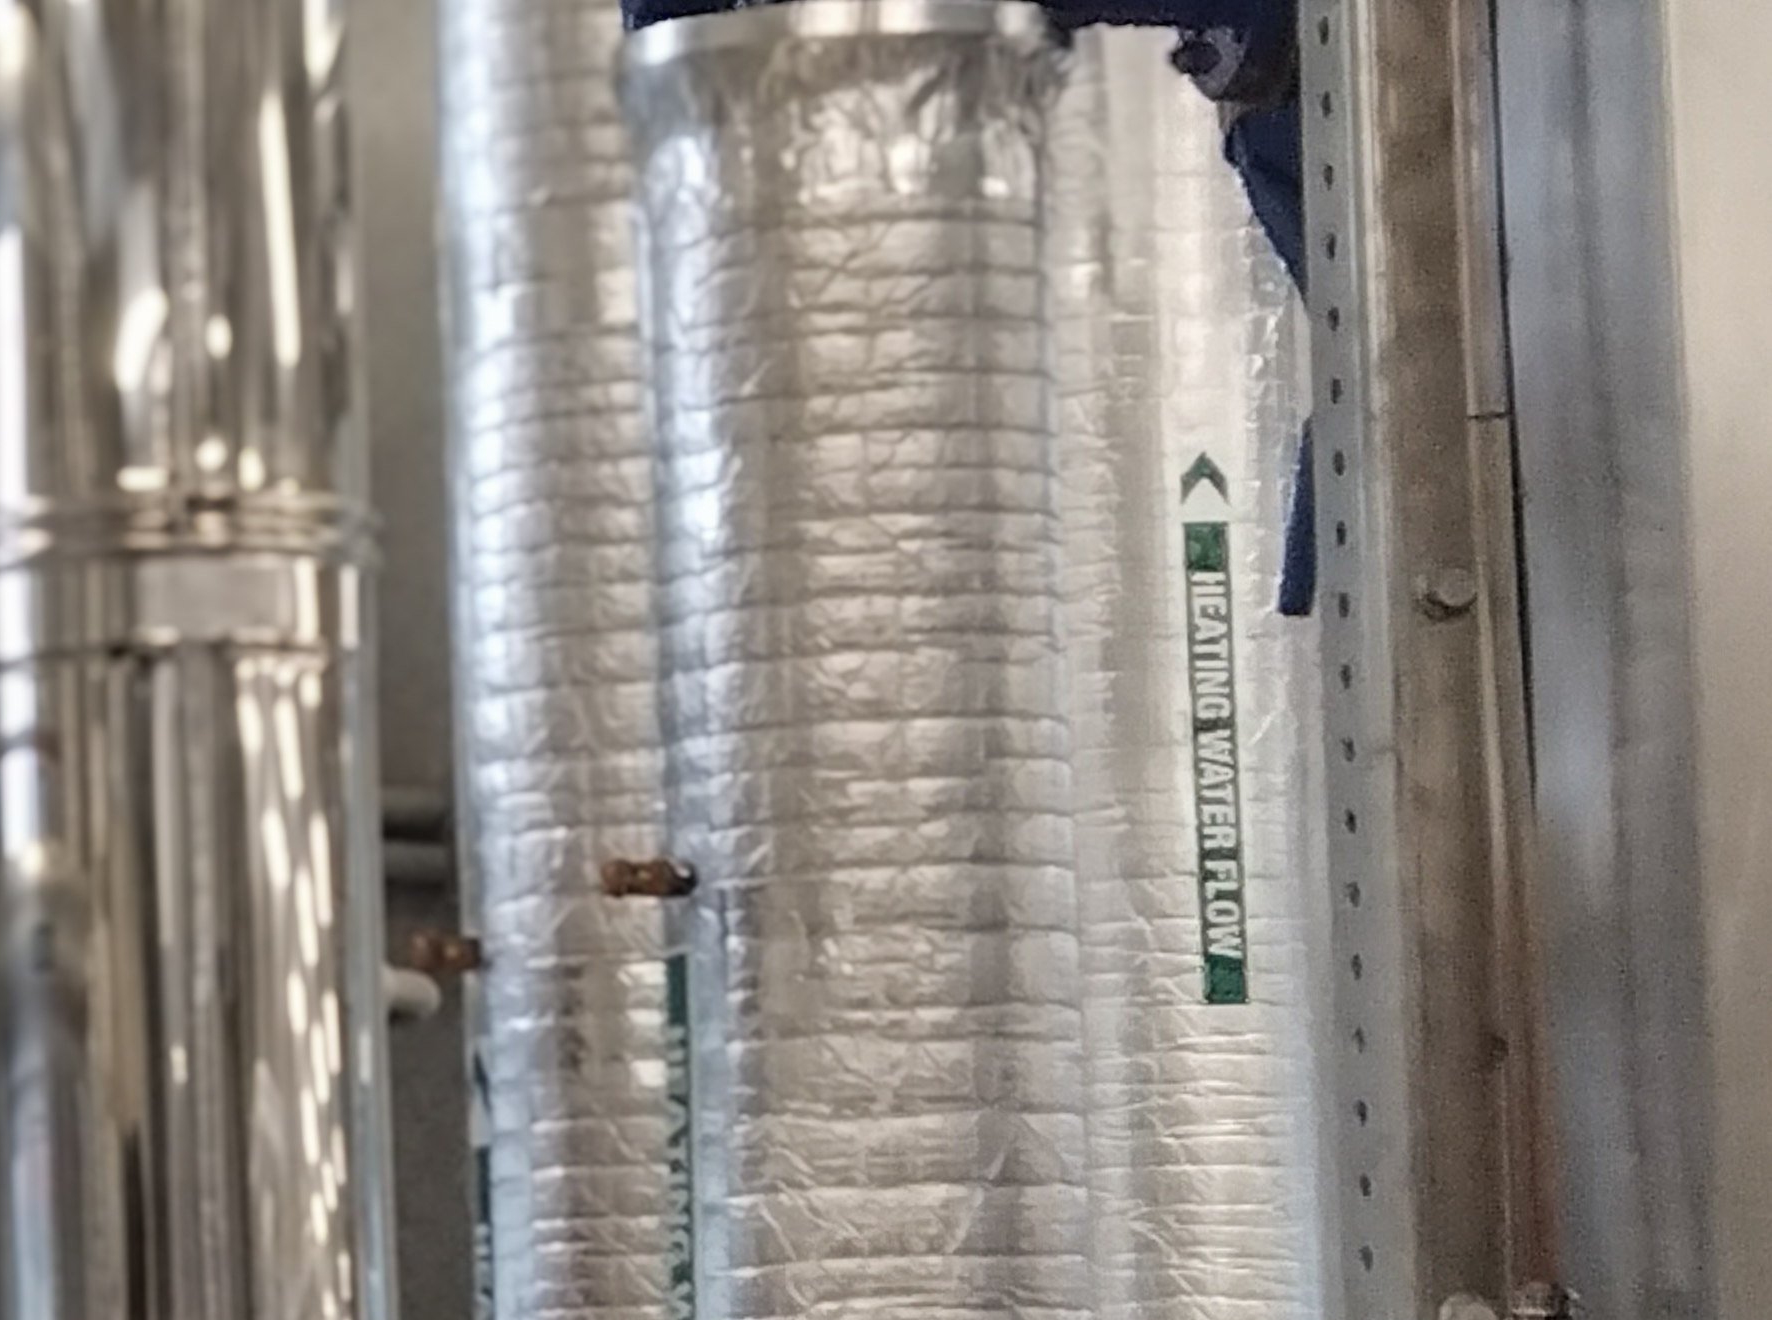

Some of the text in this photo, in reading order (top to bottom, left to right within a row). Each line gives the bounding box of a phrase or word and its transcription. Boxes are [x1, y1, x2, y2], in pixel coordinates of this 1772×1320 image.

[1189, 570, 1244, 960] HEATING WATER FLOW
